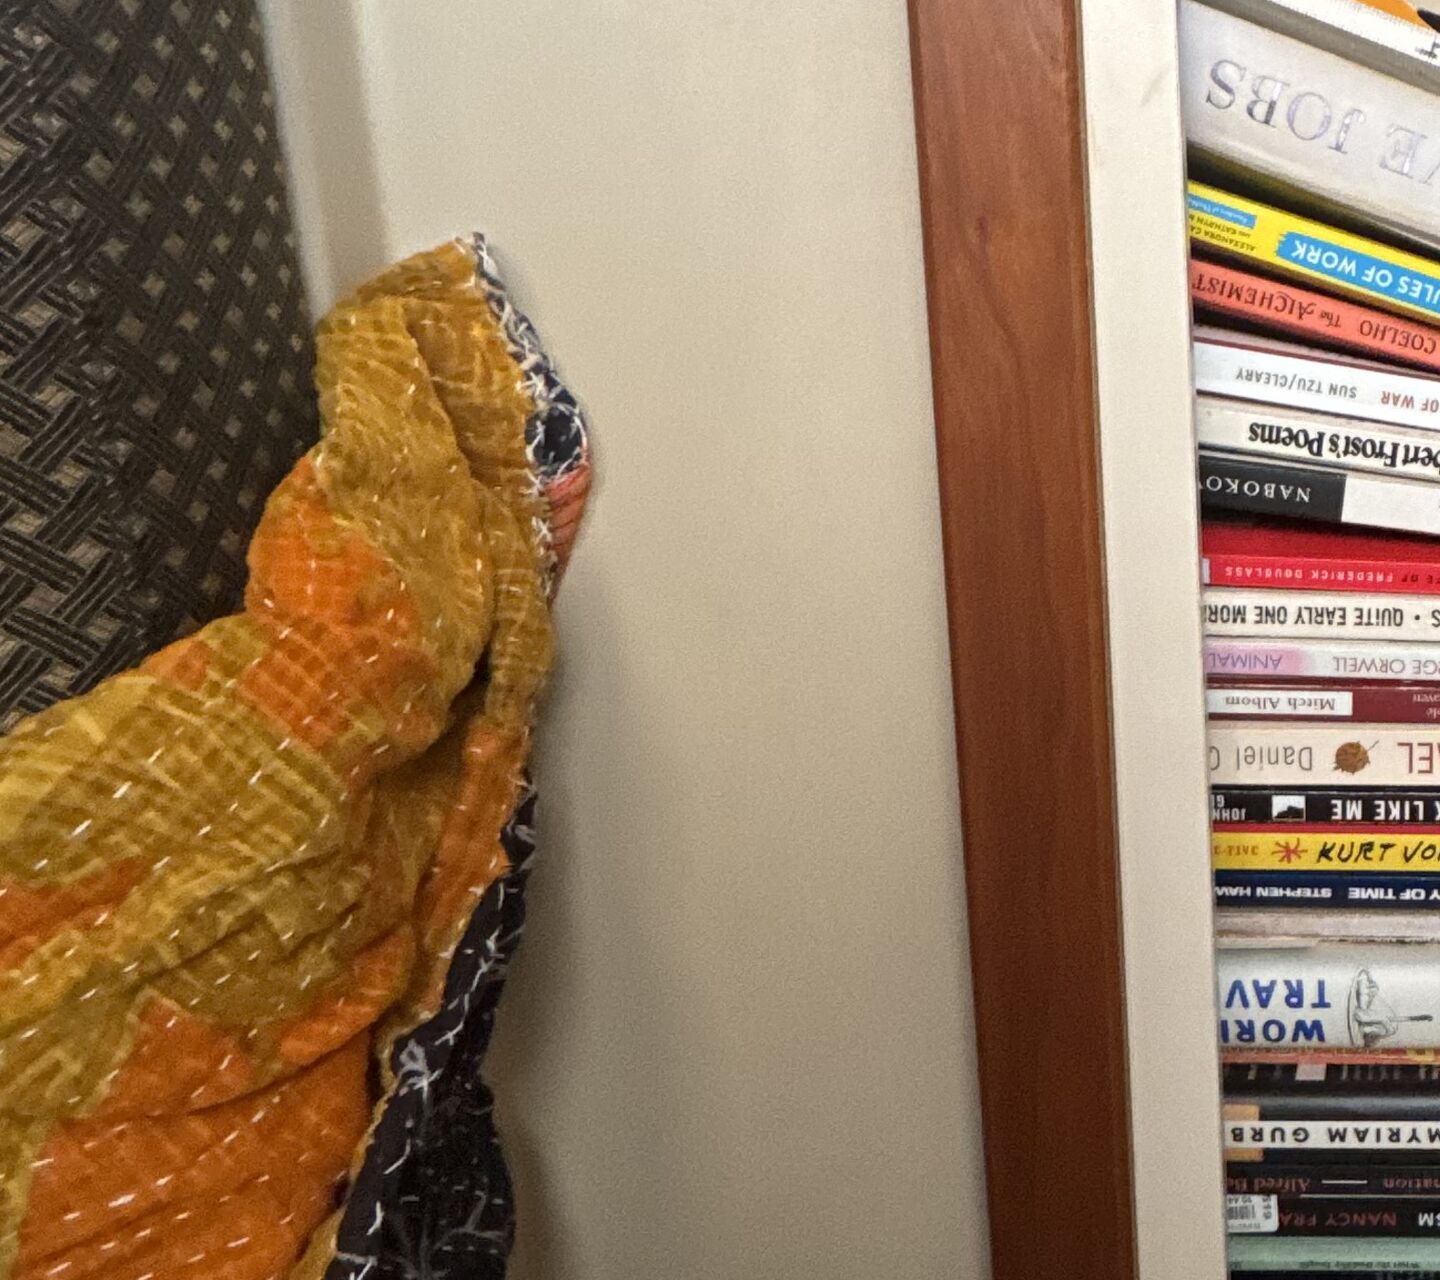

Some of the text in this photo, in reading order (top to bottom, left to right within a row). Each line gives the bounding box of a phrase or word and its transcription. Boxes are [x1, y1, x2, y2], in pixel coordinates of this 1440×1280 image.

[1206, 60, 1367, 155] JOBS
[1290, 240, 1356, 278] WORK
[1363, 264, 1393, 288] OF
[1192, 274, 1342, 328] The ALCHEMIST
[1359, 320, 1437, 356] COELHO
[1236, 367, 1358, 399] SUN TZU/CLEARY
[1380, 391, 1415, 410] WAR
[1421, 399, 1440, 415] OF
[1248, 422, 1326, 458] Poems
[1328, 434, 1400, 468] Frost's
[1224, 566, 1303, 579] DOUGLASS
[1311, 569, 1394, 583] FREDERICK
[1402, 574, 1418, 582] OF
[1254, 606, 1288, 624] ONE
[1293, 606, 1347, 626] EARLY
[1208, 652, 1282, 671] ANIMAL
[1333, 656, 1406, 675] ORWELL
[1225, 696, 1336, 710] Mitch Albom
[1236, 746, 1312, 774] Daniel
[1330, 800, 1361, 820] ME
[1374, 800, 1424, 820] LIKE
[1316, 841, 1396, 864] KURT
[1256, 886, 1332, 898] STEPHEN
[1348, 888, 1396, 900] TIME
[1400, 888, 1426, 900] OF
[1254, 1178, 1310, 1192] Alfred
[1325, 1212, 1398, 1226] NANCY
